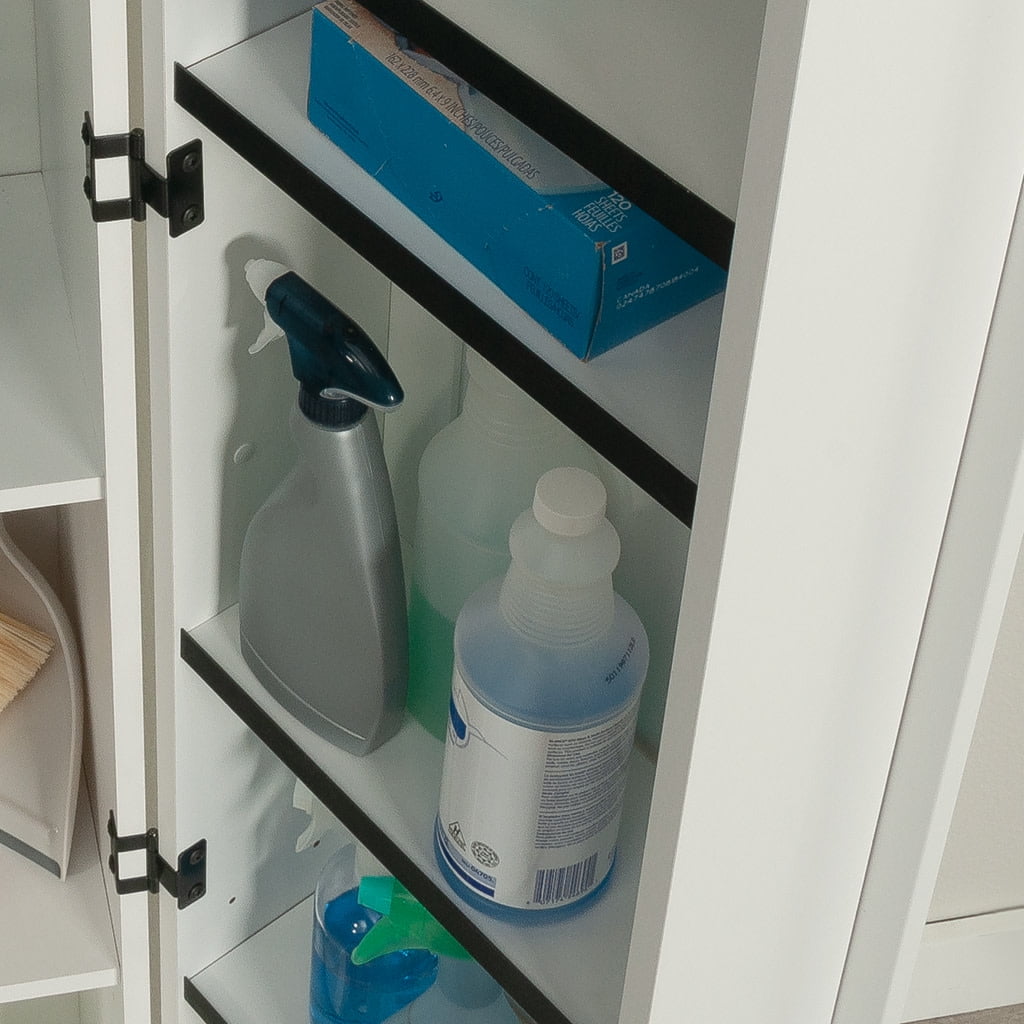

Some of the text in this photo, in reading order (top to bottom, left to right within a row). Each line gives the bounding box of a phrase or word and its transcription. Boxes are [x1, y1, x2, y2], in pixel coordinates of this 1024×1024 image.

[594, 196, 628, 224] SHEETS
[608, 191, 632, 211] 120
[571, 209, 602, 232] HOJAS
[583, 202, 623, 233] FEUILLES
